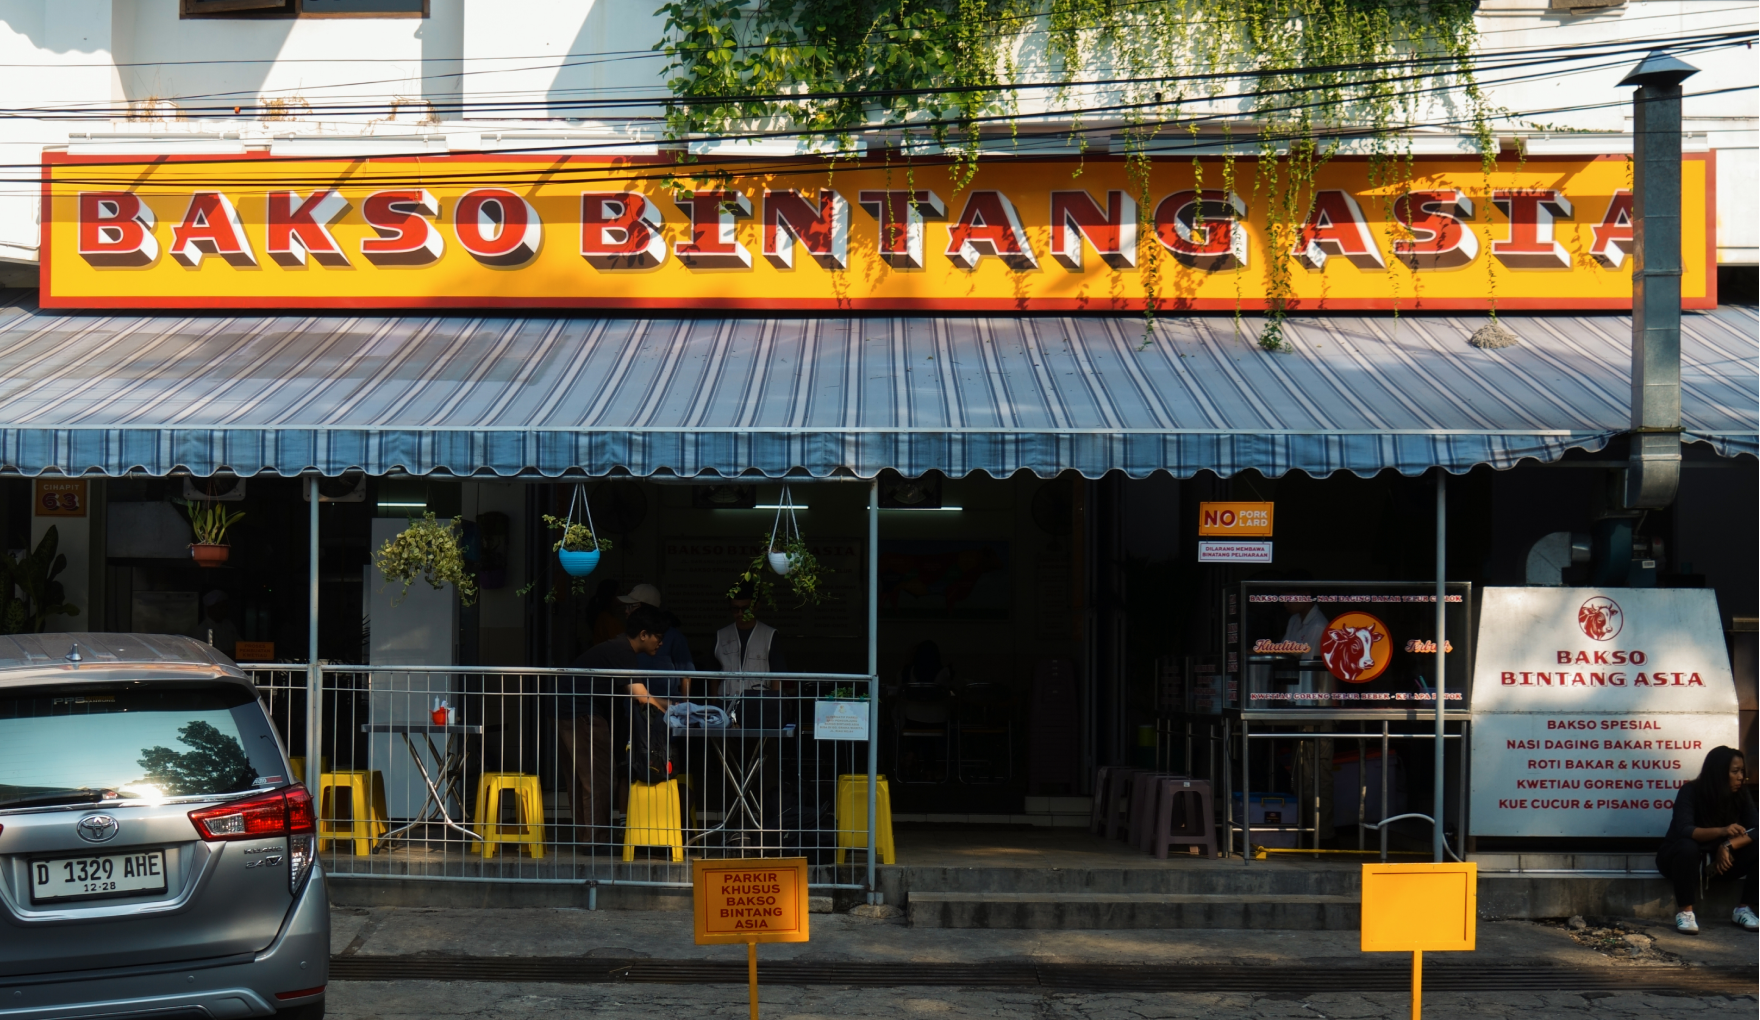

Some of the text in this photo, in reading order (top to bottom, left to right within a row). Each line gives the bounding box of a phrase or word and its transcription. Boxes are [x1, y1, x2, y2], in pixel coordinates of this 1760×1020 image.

[77, 188, 1635, 269] BAKSO BINTANG ASIA
[42, 492, 80, 511] 63
[1204, 510, 1237, 528] NO
[1239, 510, 1268, 518] PORK
[1239, 519, 1268, 527] LARD
[1253, 638, 1311, 653] Kualitas
[1404, 639, 1453, 653] Terbak
[1556, 650, 1648, 666] BAKSO
[1500, 671, 1706, 687] BINTANG ASIA
[1547, 720, 1661, 730] BAKSO SPESIAL
[1506, 740, 1702, 750] NASI DAGING BAKAR TELUR
[1527, 760, 1681, 770] ROTI BAKAR & KUKUS
[1517, 779, 1580, 789] KWETIAU
[1584, 779, 1644, 789] GORENG
[1498, 799, 1528, 809] KUE
[1530, 799, 1580, 809] CUCUR
[1583, 799, 1594, 809] &
[1597, 799, 1650, 809] PISANG
[37, 855, 160, 885] D 1329 AHE
[723, 873, 777, 883] PARKIR
[721, 884, 781, 895] KHUSUS
[726, 896, 776, 906] BAKSO
[720, 907, 783, 918] BINTANG
[734, 919, 768, 929] ASIA
